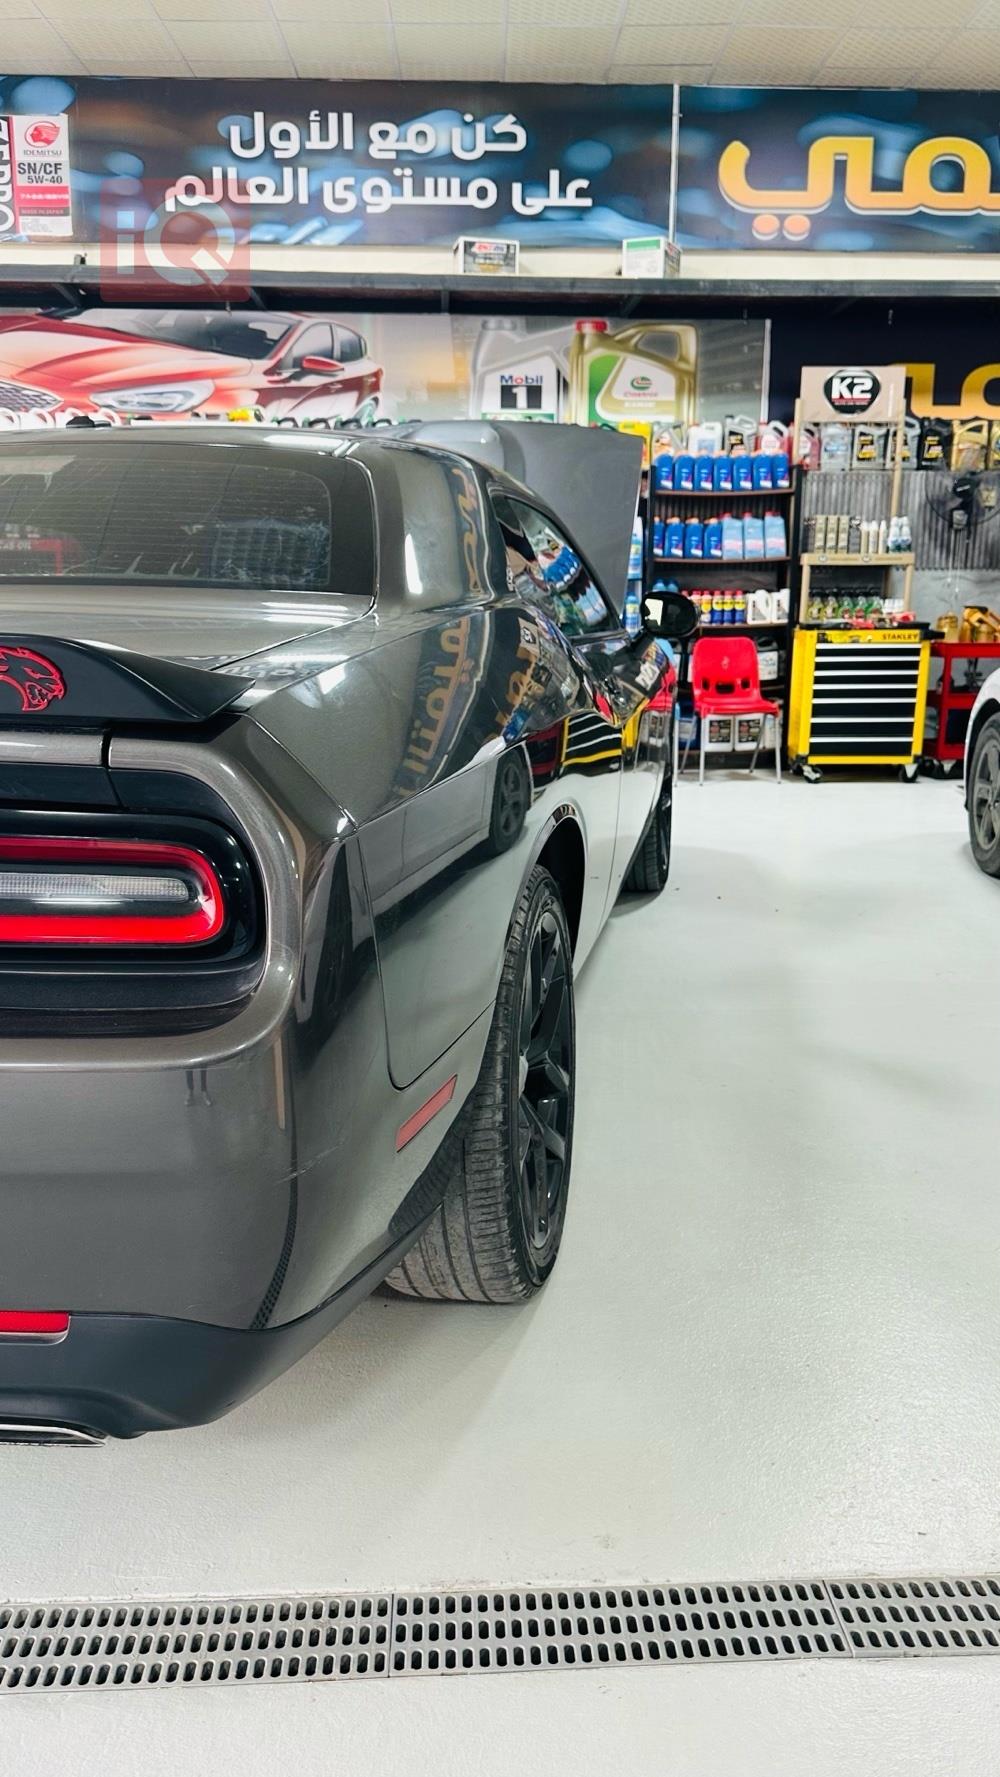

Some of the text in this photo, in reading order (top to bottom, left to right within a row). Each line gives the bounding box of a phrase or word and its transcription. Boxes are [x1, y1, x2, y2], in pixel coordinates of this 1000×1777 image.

[229, 109, 527, 161] كن مع الأول
[17, 162, 62, 175] SN/CF
[27, 175, 63, 184] 5W-40
[165, 166, 593, 215] على مستوى العالم
[718, 136, 1000, 241] مي
[501, 374, 543, 386] Mobil
[831, 377, 874, 399] K2
[511, 386, 530, 409] 1
[882, 633, 918, 641] STANLEY
